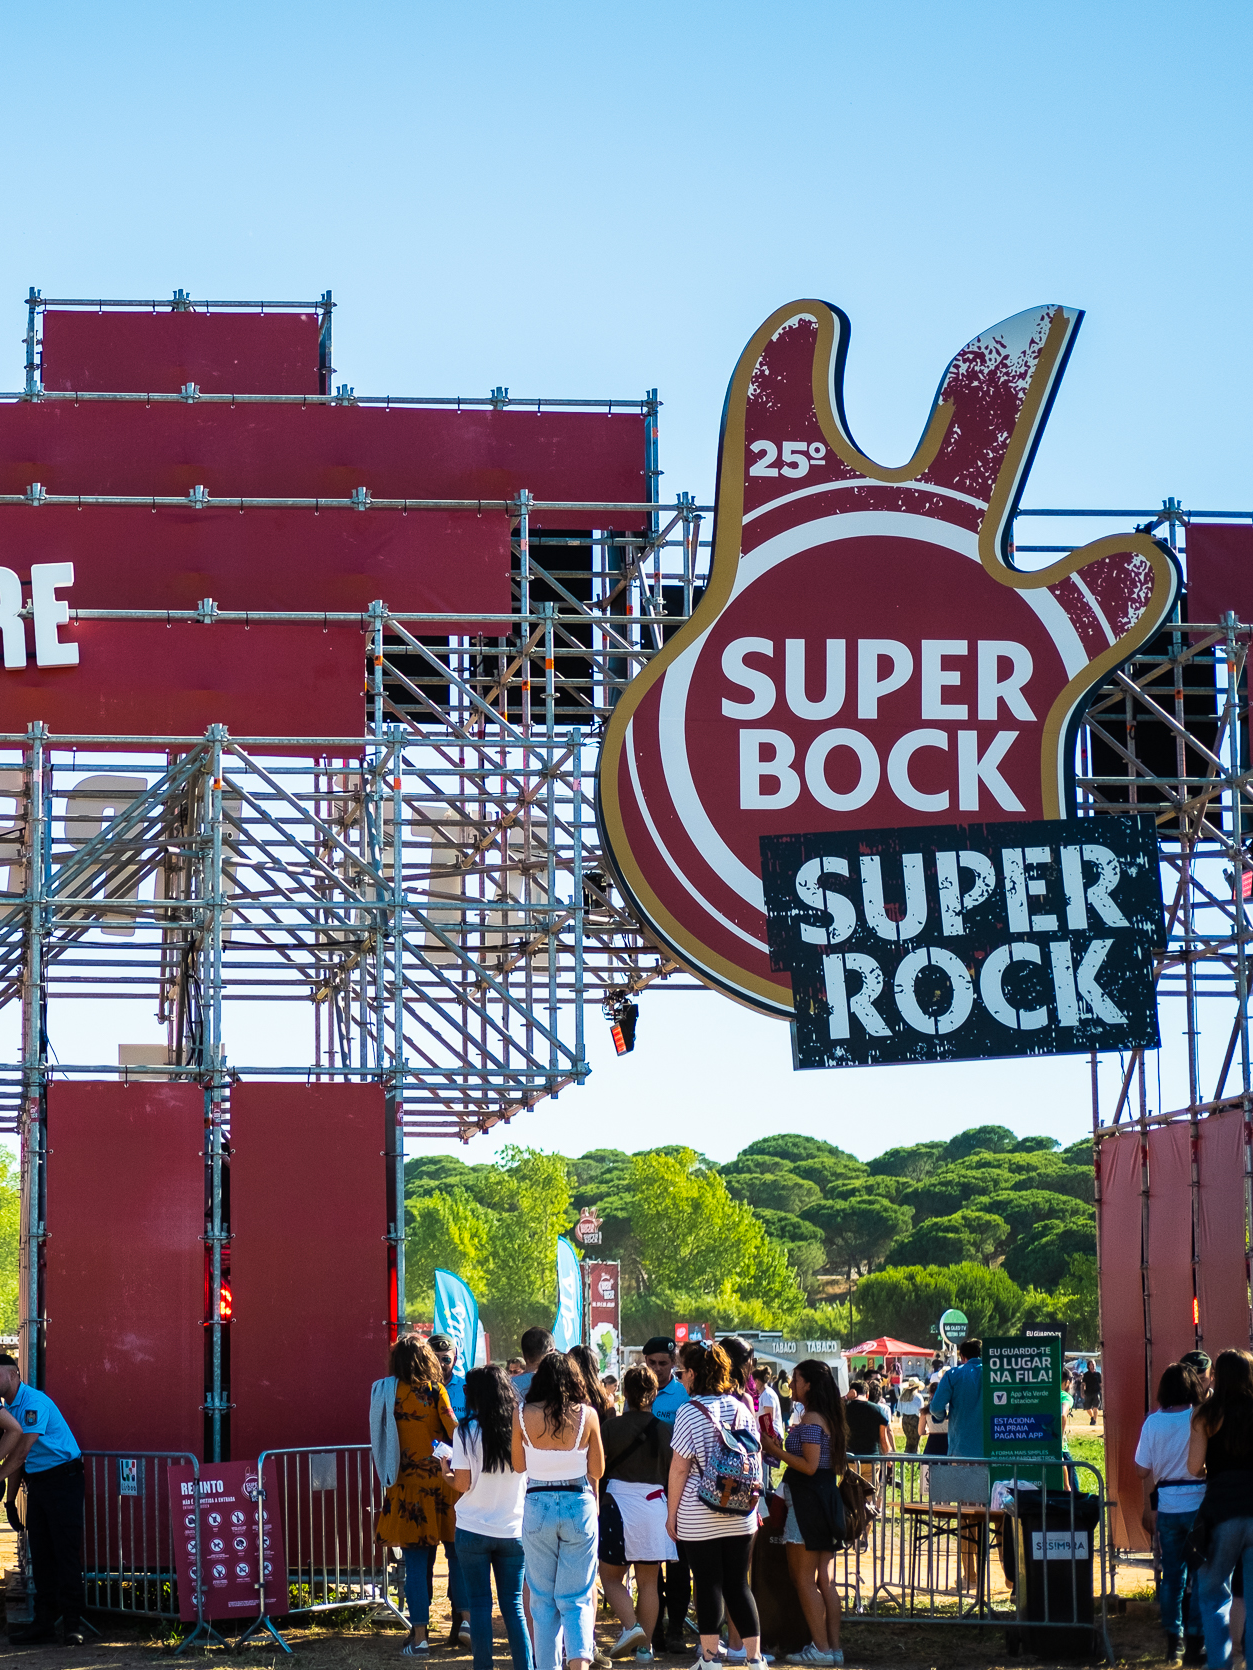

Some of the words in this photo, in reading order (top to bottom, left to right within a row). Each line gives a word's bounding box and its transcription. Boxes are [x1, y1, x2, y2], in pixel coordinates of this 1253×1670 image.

[721, 637, 1038, 722] SUPER
[739, 728, 1027, 813] BOCK
[795, 844, 1131, 946] SUPER
[822, 938, 1130, 1041] ROCK
[772, 1342, 796, 1353] TABACO
[807, 1341, 837, 1352] TABACO
[989, 1348, 1000, 1356] EU
[1002, 1346, 1051, 1355] GUARDO-TE
[990, 1358, 1000, 1369] O
[1004, 1357, 1051, 1369] LUGAR
[990, 1371, 1012, 1383] NA
[1016, 1370, 1053, 1382] FILA!
[657, 1411, 671, 1419] GNR
[181, 1480, 224, 1495] REINTO
